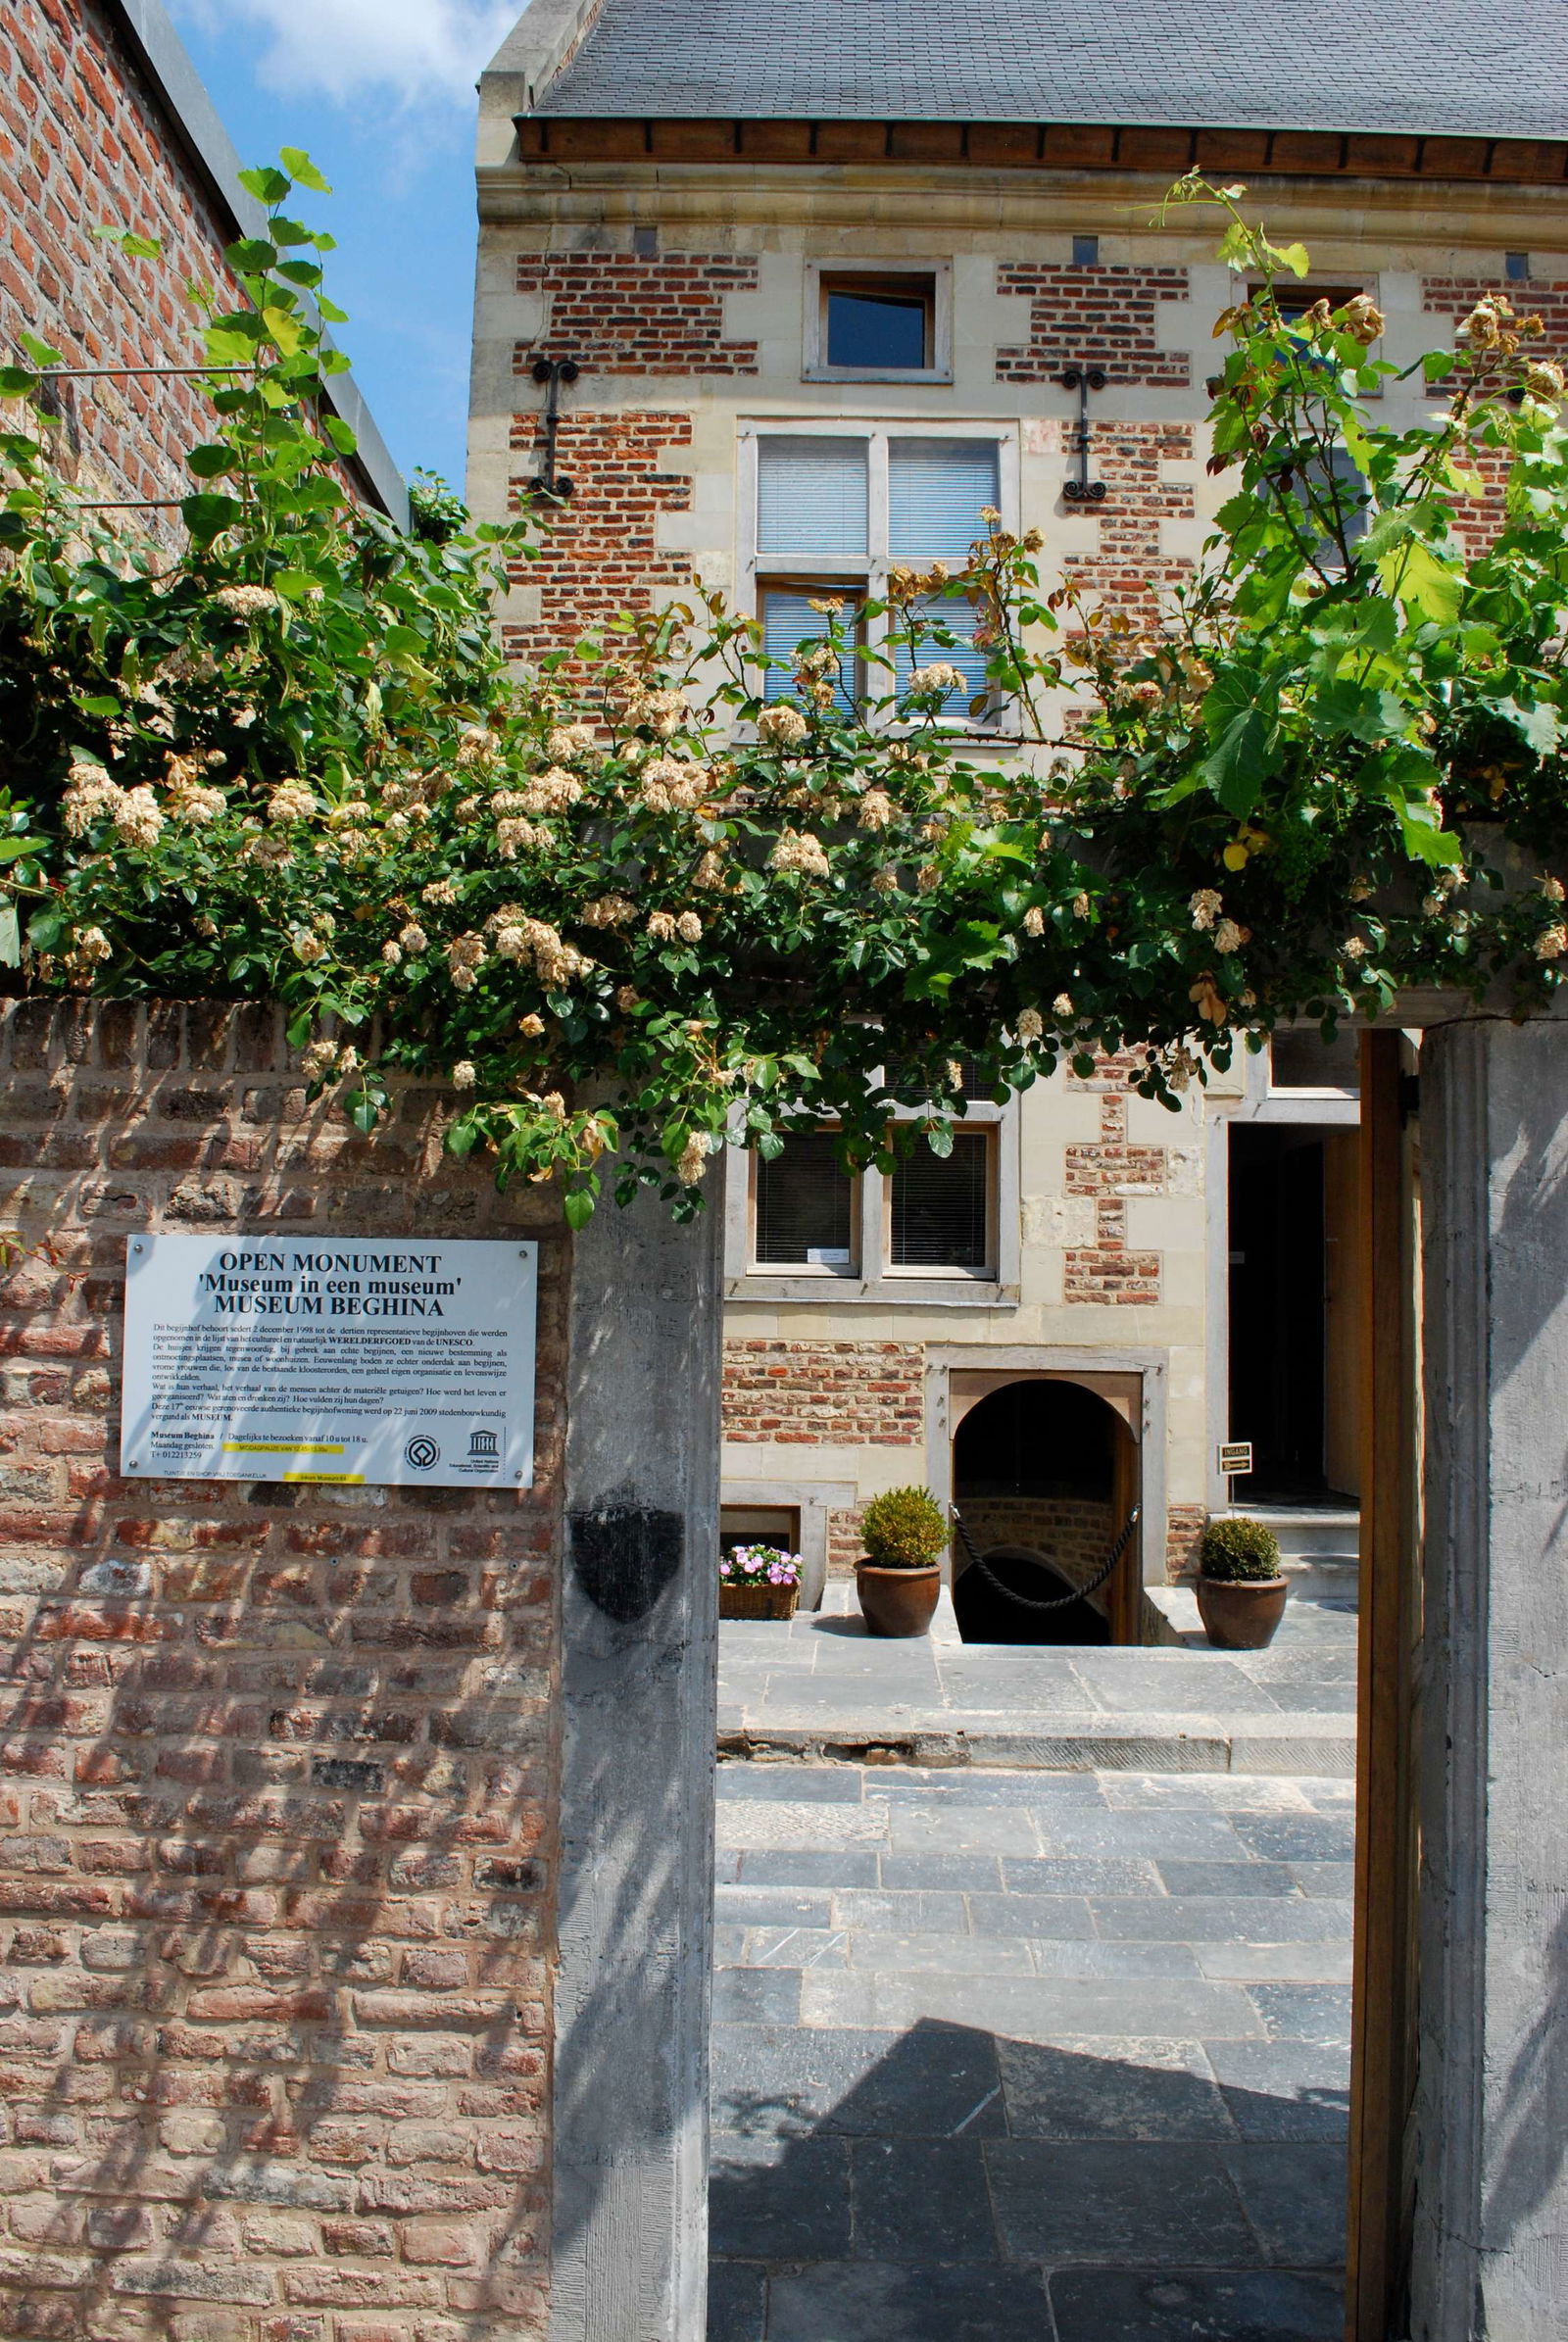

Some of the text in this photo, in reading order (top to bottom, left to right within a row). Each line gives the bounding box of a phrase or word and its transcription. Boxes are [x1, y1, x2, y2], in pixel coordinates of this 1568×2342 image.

[220, 1252, 442, 1274] OPEN MONUMENT
[199, 1274, 462, 1295] 'Museum in een museum'
[214, 1295, 444, 1316] MUSEUM BEGHINA
[367, 1328, 420, 1337] representatieve
[421, 1329, 466, 1338] begijnhoven
[293, 1337, 326, 1345] natuurlijk
[329, 1337, 411, 1345] WERELDERFGOED
[196, 1344, 220, 1353] krijgen
[280, 1345, 290, 1354] bij
[295, 1346, 318, 1355] gebrek
[364, 1347, 397, 1356] begijnen,
[449, 1348, 492, 1358] bestemming
[314, 1356, 357, 1365] Eeuwenlang
[473, 1358, 507, 1368] begijnen,
[366, 1367, 389, 1376] geheel
[391, 1367, 411, 1376] eigen
[413, 1368, 452, 1377] organisatie
[465, 1369, 507, 1378] levenswijze
[389, 1388, 424, 1396] getuigen?
[152, 1393, 204, 1402] georganiseerd?
[277, 1395, 290, 1404] zij?
[334, 1396, 344, 1405] zij
[359, 1396, 383, 1405] dagen?
[152, 1412, 179, 1422] vergund
[302, 1406, 362, 1416] begijnhofwoning
[404, 1408, 417, 1417] juni
[439, 1408, 506, 1418] stedenbouwkundig
[184, 1433, 215, 1441] Beghina
[228, 1433, 262, 1442] Dagelijks
[151, 1440, 181, 1450] Maandag
[1224, 1446, 1249, 1457] INGANG
